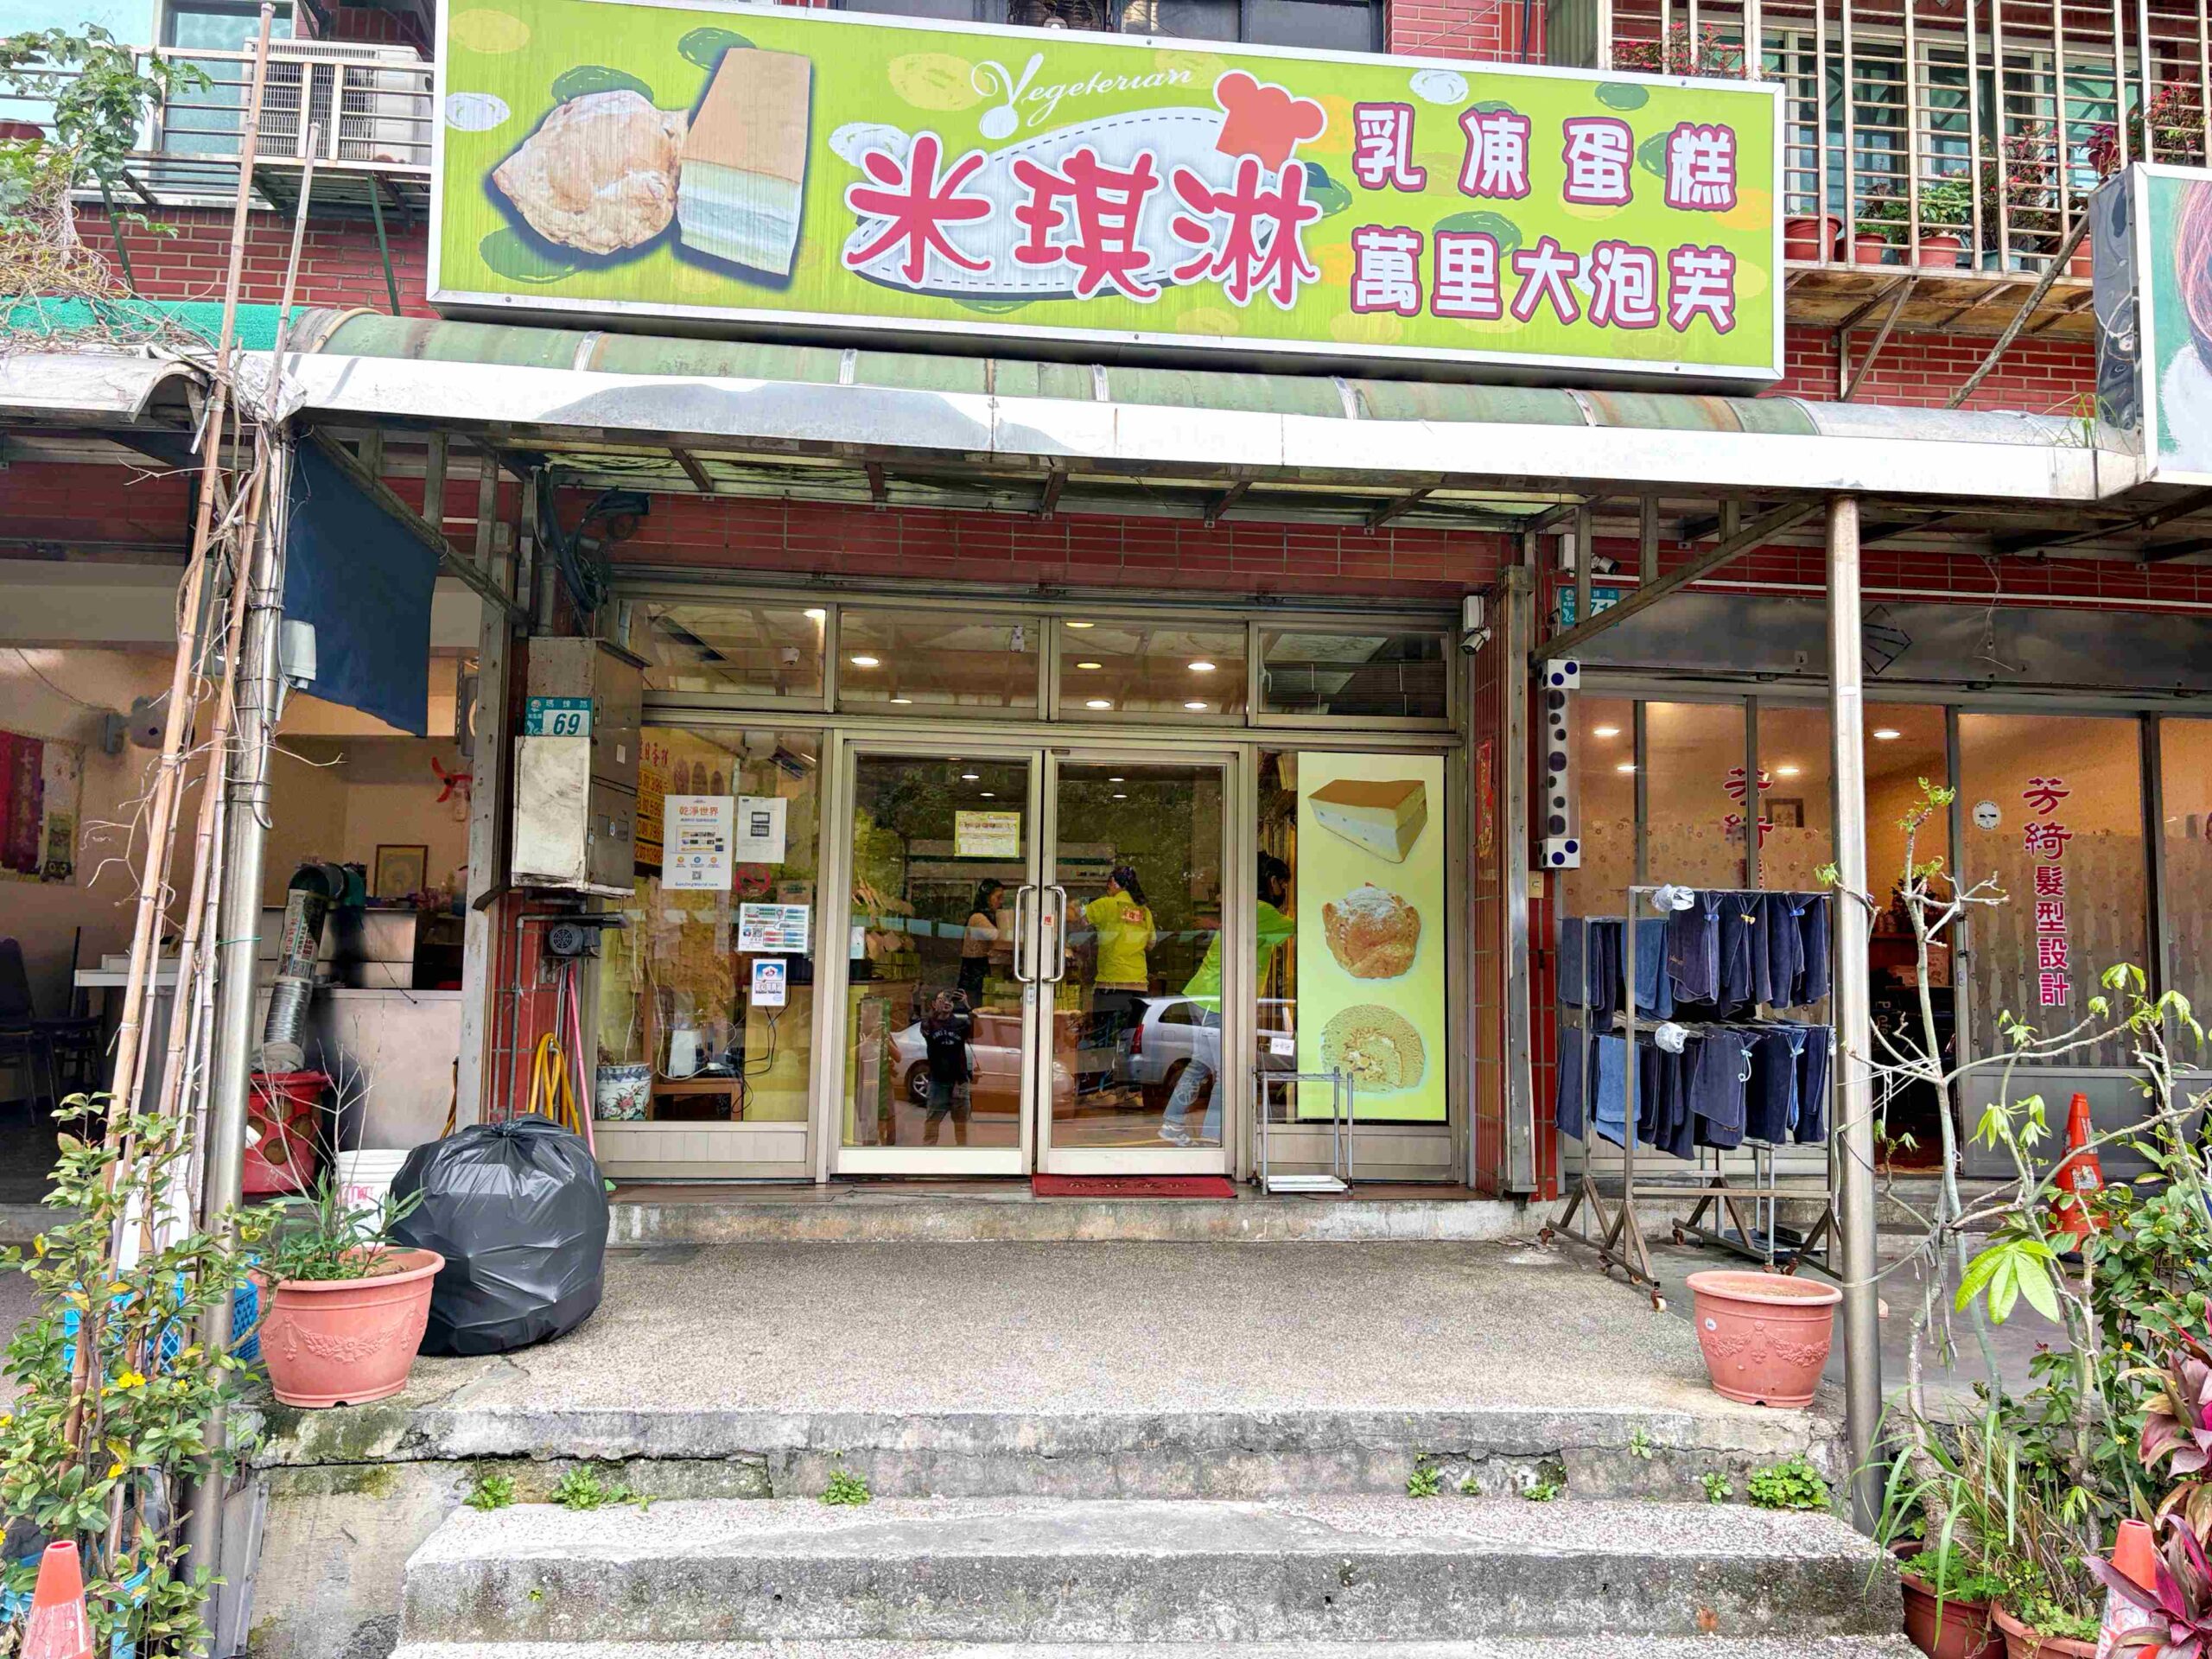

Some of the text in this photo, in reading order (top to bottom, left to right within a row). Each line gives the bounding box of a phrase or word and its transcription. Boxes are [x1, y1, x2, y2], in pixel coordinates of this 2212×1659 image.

[1354, 104, 1735, 210] 乳凍蛋糕
[844, 133, 1323, 308] 米琪淋
[1351, 226, 1735, 334] 萬里大泡芙
[554, 713, 581, 734] 69
[679, 805, 719, 816] 乾淨世界
[2023, 778, 2073, 1007] 芳綺髮型設計
